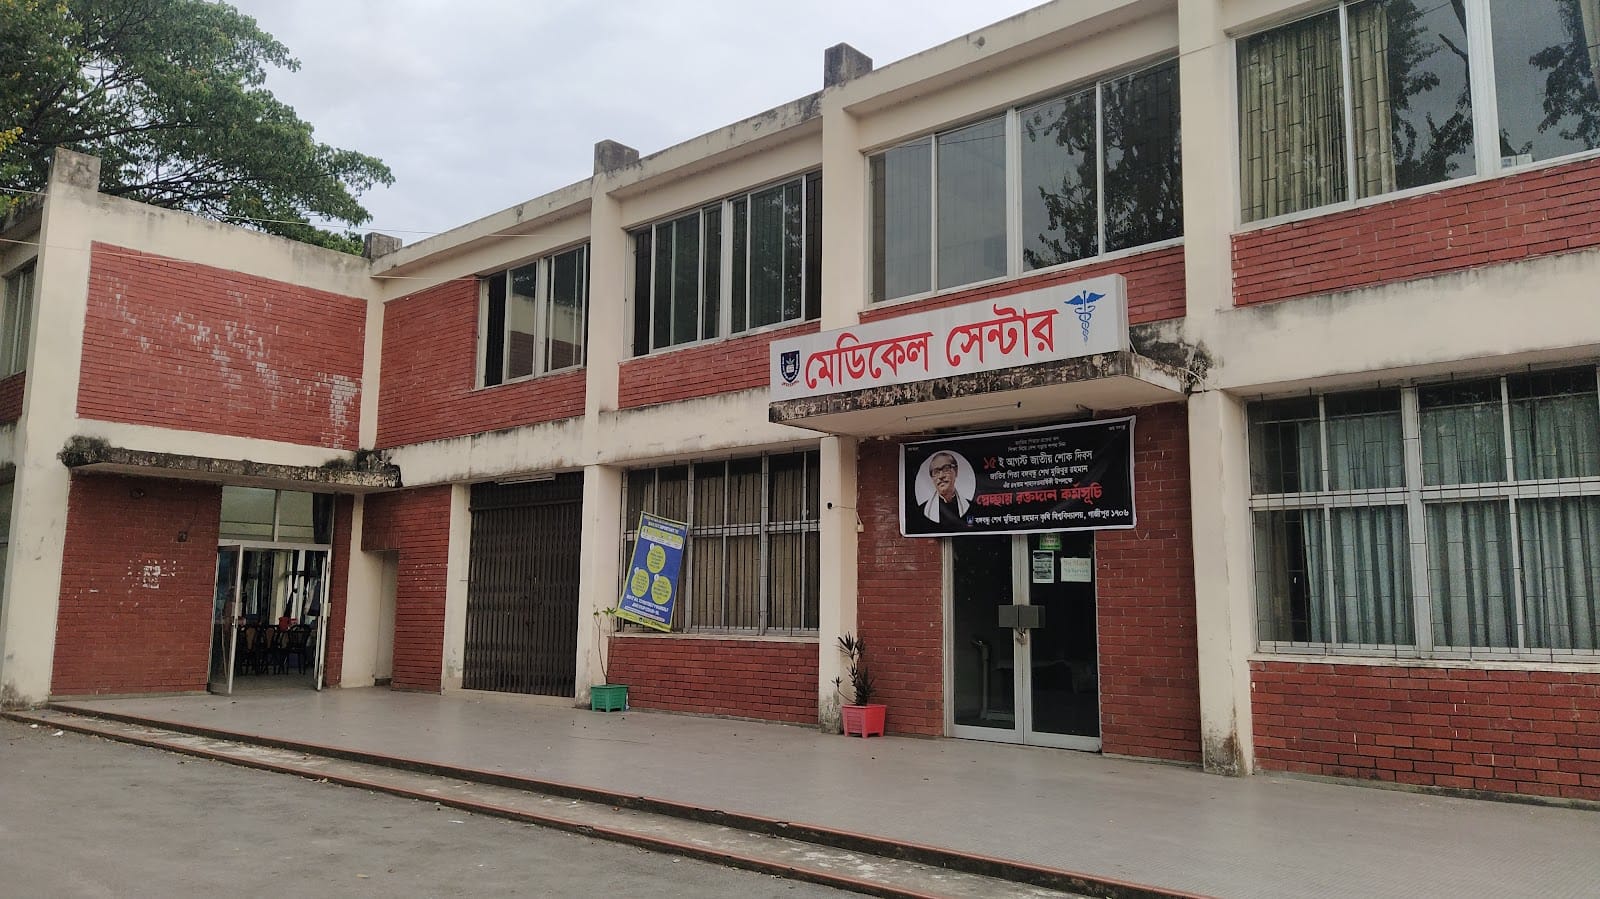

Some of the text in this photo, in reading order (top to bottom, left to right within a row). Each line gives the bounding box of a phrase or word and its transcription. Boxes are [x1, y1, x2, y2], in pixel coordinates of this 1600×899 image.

[805, 303, 1059, 389] মেডিকেল সেন্টার
[983, 449, 1093, 470] ১৫ ই আগস্ট জাতীয় শোক দিবস
[990, 465, 1088, 480] জাতির পিতা বঙ্গবন্ধু শেখ মুজিবুর রহমান
[976, 482, 1103, 507] স্বেচ্ছায় রক্তদান কর্মসূচি
[975, 516, 991, 525] বঙ্গবন্ধু
[1003, 514, 1020, 524] মুজিবুর
[1022, 514, 1039, 522] রহমান
[1040, 512, 1050, 523] কৃষি
[1088, 508, 1109, 519] গাজীপুর
[1111, 509, 1129, 517] ১৭০৬
